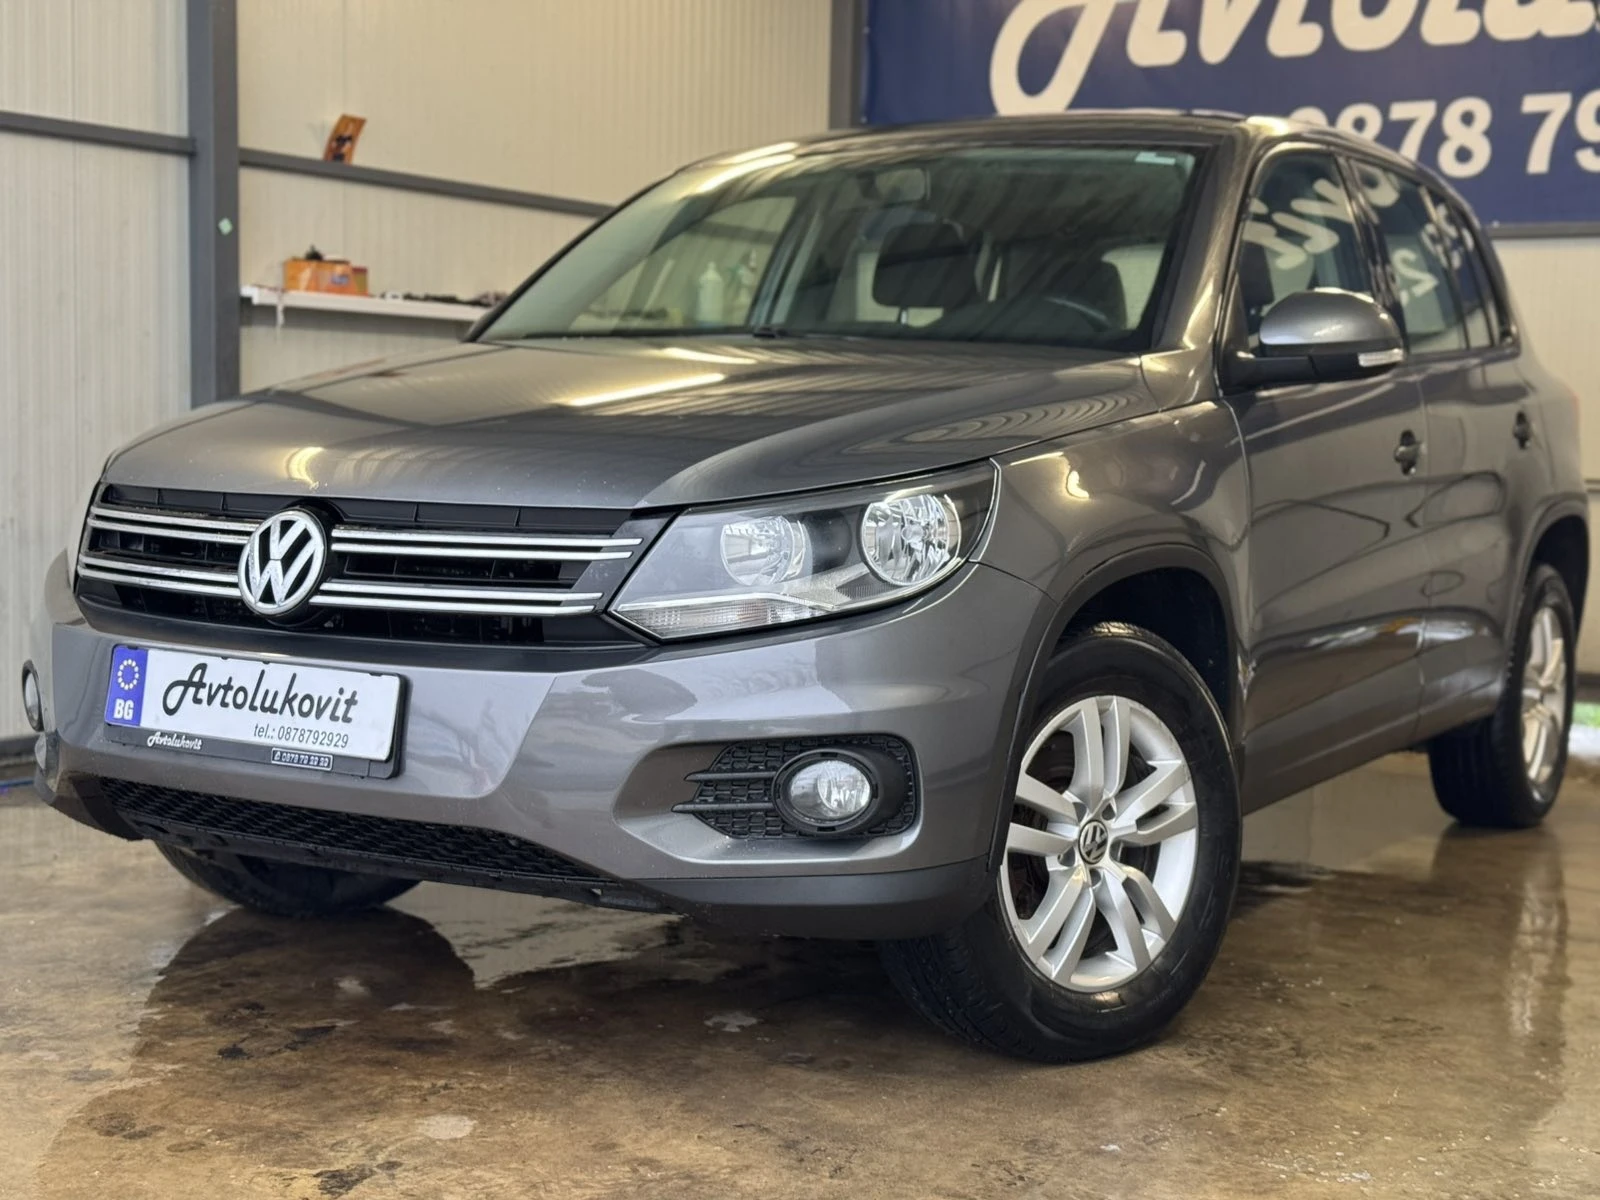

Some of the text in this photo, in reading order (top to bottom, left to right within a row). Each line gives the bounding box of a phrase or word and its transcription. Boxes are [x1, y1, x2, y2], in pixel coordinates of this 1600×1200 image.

[162, 662, 358, 723] Avtolukovit
[113, 698, 135, 720] BG
[147, 731, 202, 750] Avtolukovit
[253, 723, 349, 748] tel.: 0878792929
